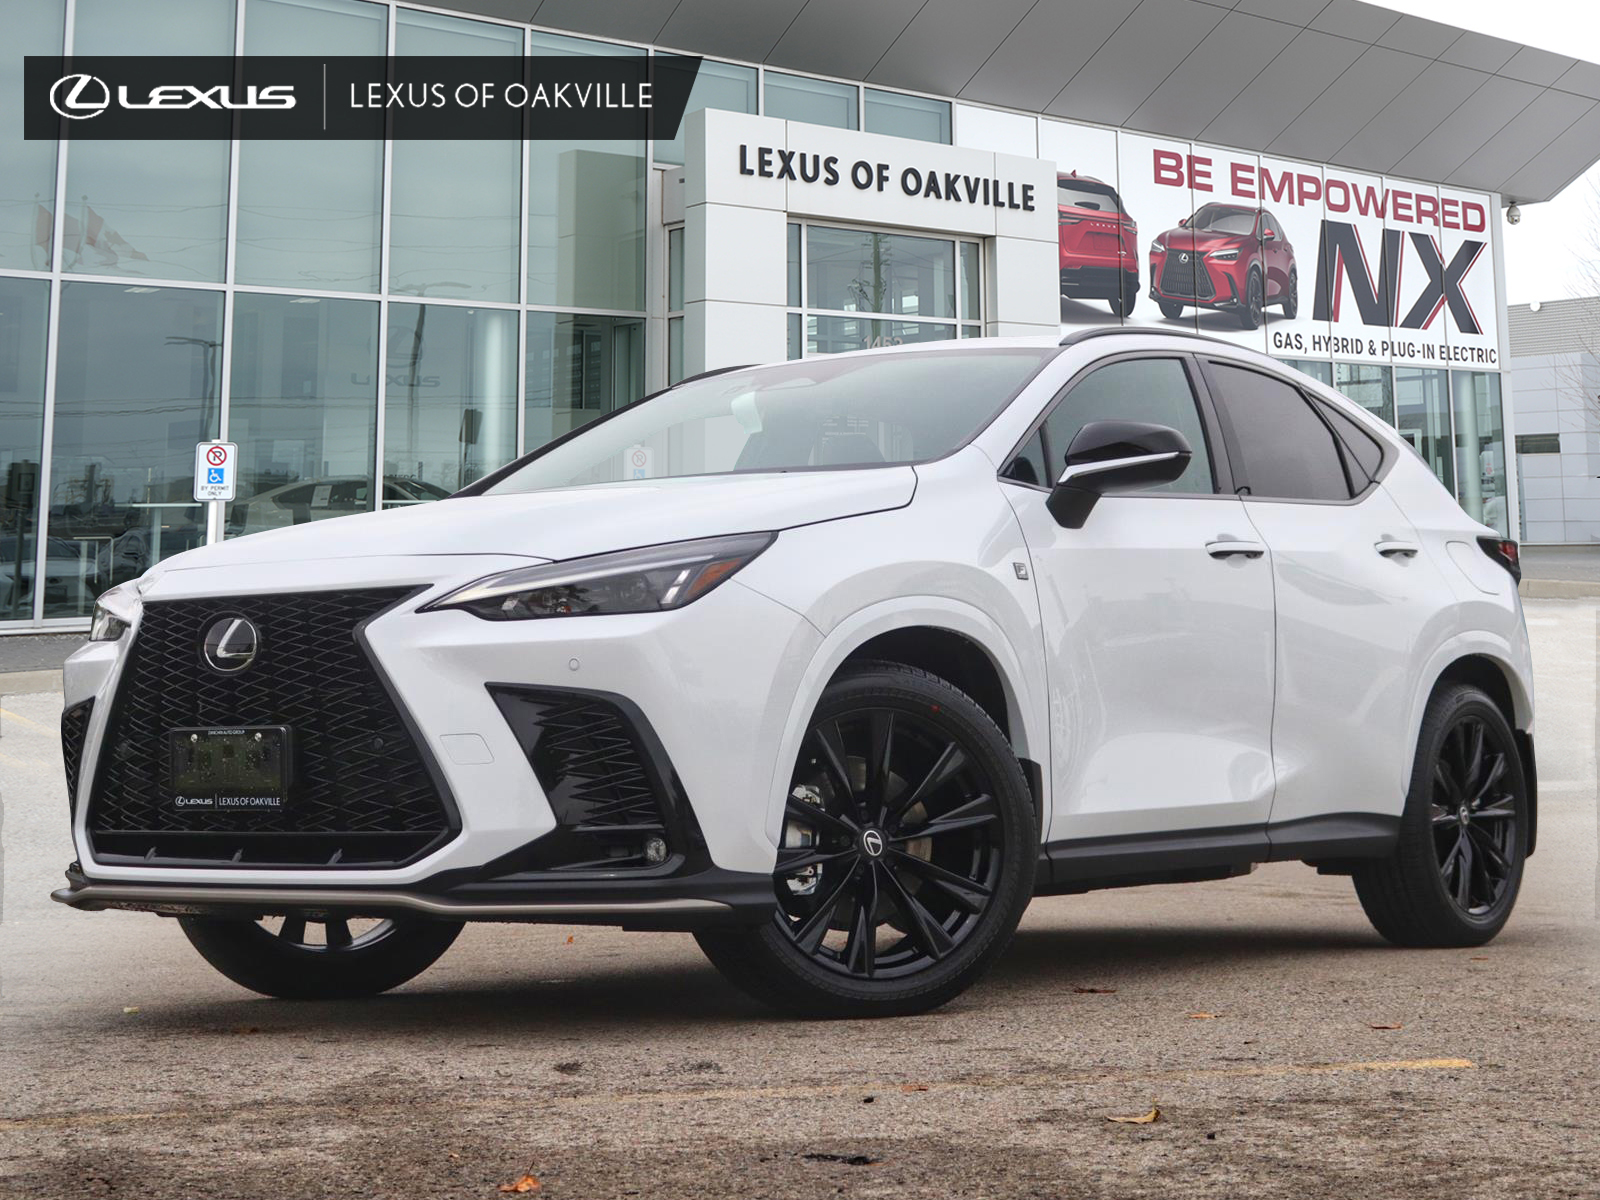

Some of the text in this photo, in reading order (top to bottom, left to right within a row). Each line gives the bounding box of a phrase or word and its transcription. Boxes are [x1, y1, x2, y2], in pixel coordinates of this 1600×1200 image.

[739, 144, 1036, 212] LEXUS OF OAKVILLE
[1152, 148, 1486, 233] BE EMPOWERED
[1312, 218, 1488, 336] NX
[1273, 331, 1497, 364] GAS, HYBRID & PLUG-IN ELECTRIC
[219, 797, 281, 806] LEXUS OF OAKVILLE
